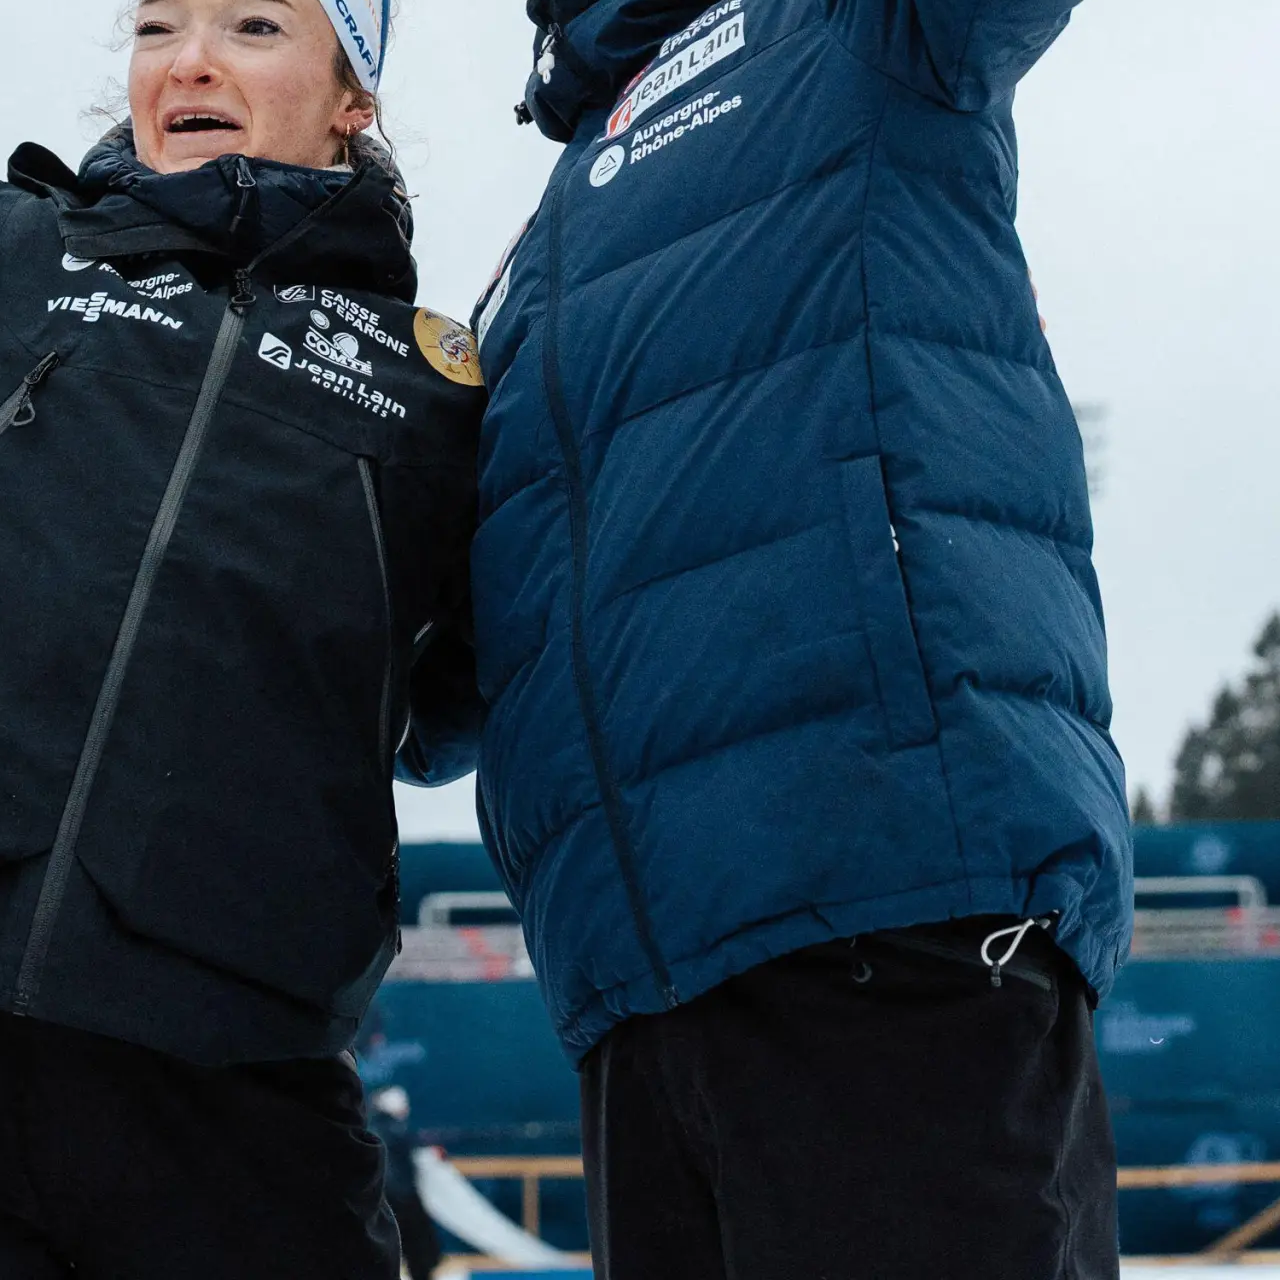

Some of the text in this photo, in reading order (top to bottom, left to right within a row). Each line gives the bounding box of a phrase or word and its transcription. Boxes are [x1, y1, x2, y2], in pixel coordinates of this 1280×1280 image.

[688, 21, 740, 70] Lain
[630, 90, 721, 148] Auvergne-
[630, 94, 743, 165] Rhône-Alpes
[126, 272, 181, 290] ergne-
[47, 291, 184, 330] VIESSMANN
[320, 289, 381, 327] CAISSE
[293, 358, 407, 419] Jean Lain
[311, 375, 389, 419] MOBILITÉS
